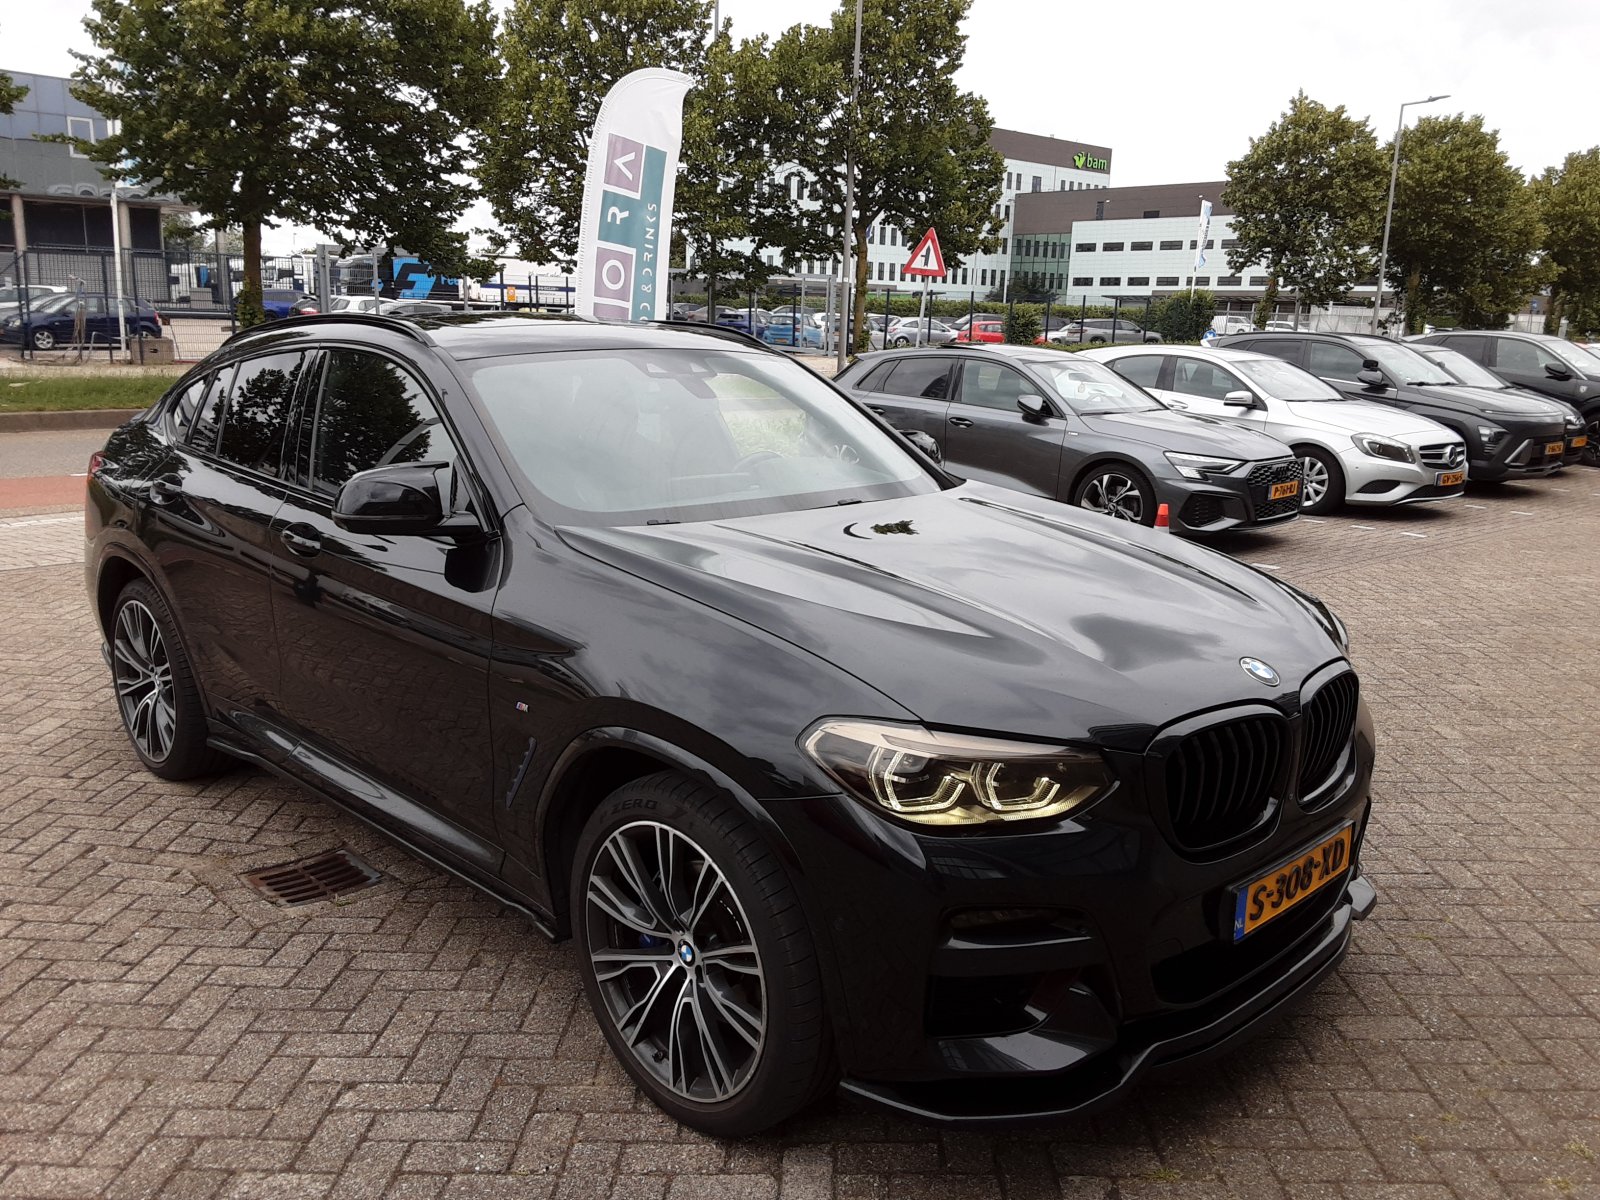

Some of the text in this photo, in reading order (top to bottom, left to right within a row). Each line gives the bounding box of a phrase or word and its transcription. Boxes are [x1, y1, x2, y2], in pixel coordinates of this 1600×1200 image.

[1086, 152, 1107, 171] bam
[602, 151, 636, 291] ORA
[642, 203, 657, 277] DRINKS
[641, 283, 653, 294] &
[1249, 837, 1346, 921] S-308-XD
